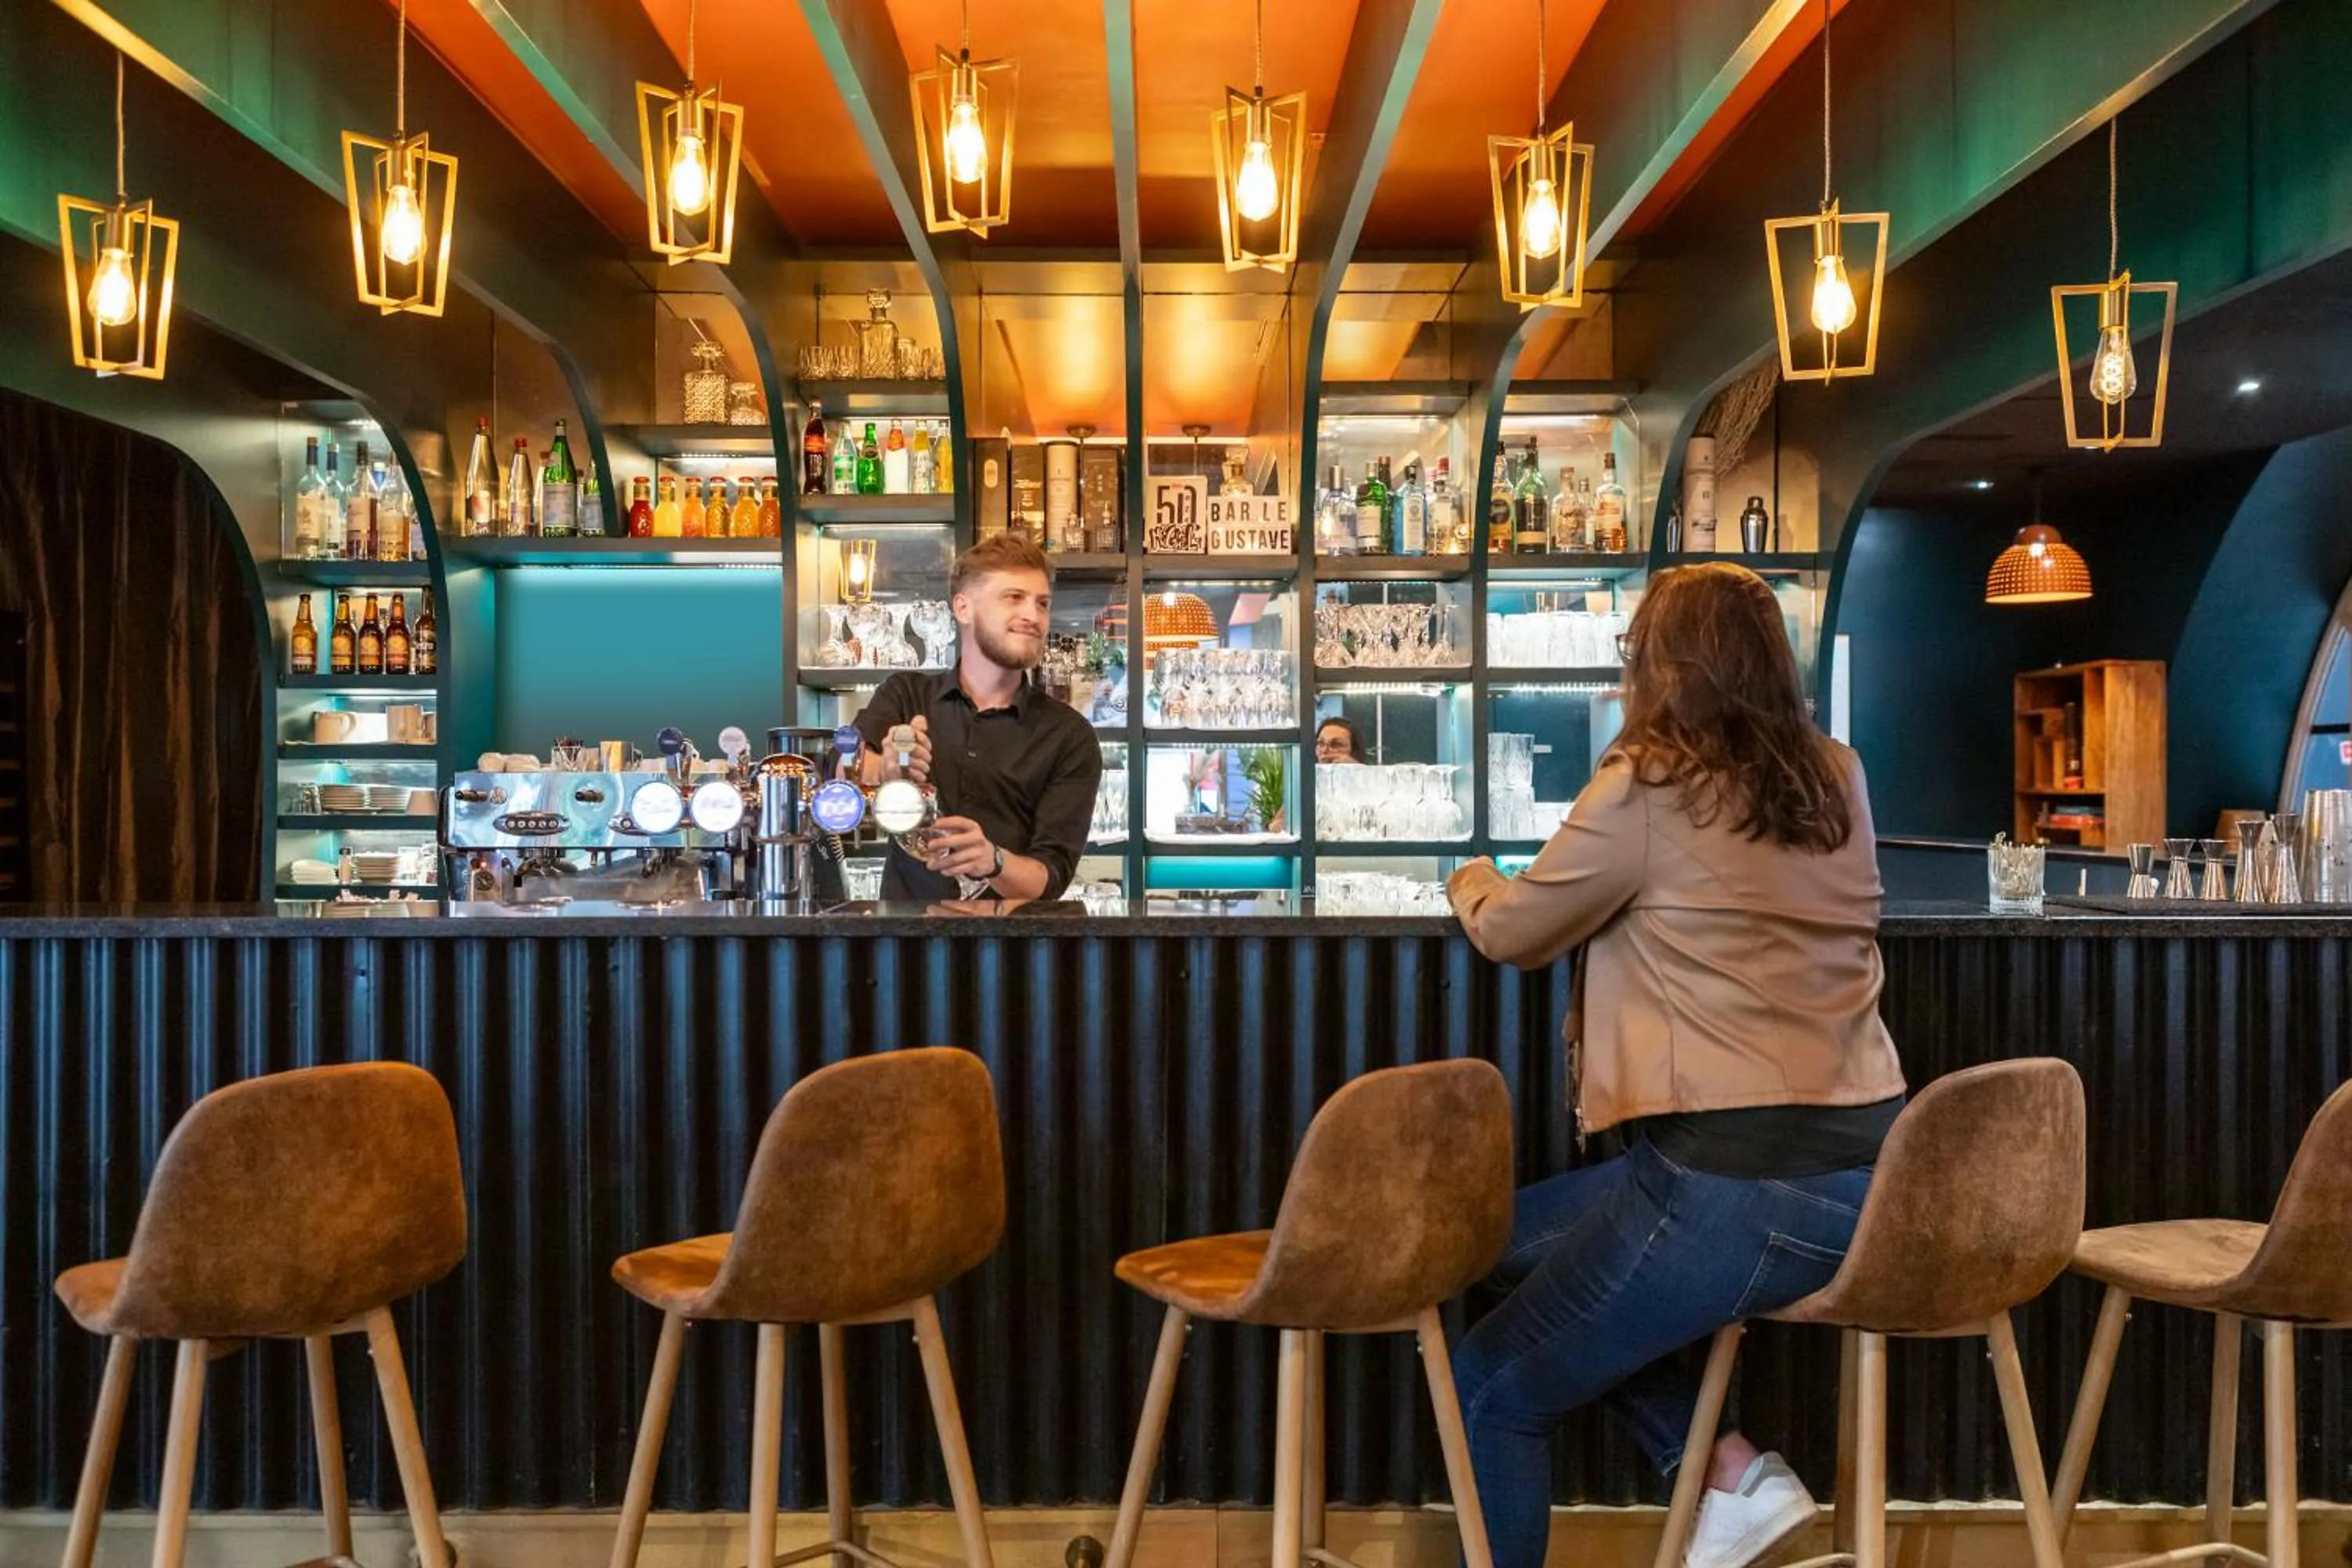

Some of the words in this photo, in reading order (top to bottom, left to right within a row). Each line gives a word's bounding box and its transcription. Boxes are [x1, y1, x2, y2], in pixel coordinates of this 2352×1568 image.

[1210, 502, 1250, 522] BAR
[1263, 501, 1287, 521] LE
[1210, 529, 1289, 550] GUSTAVE
